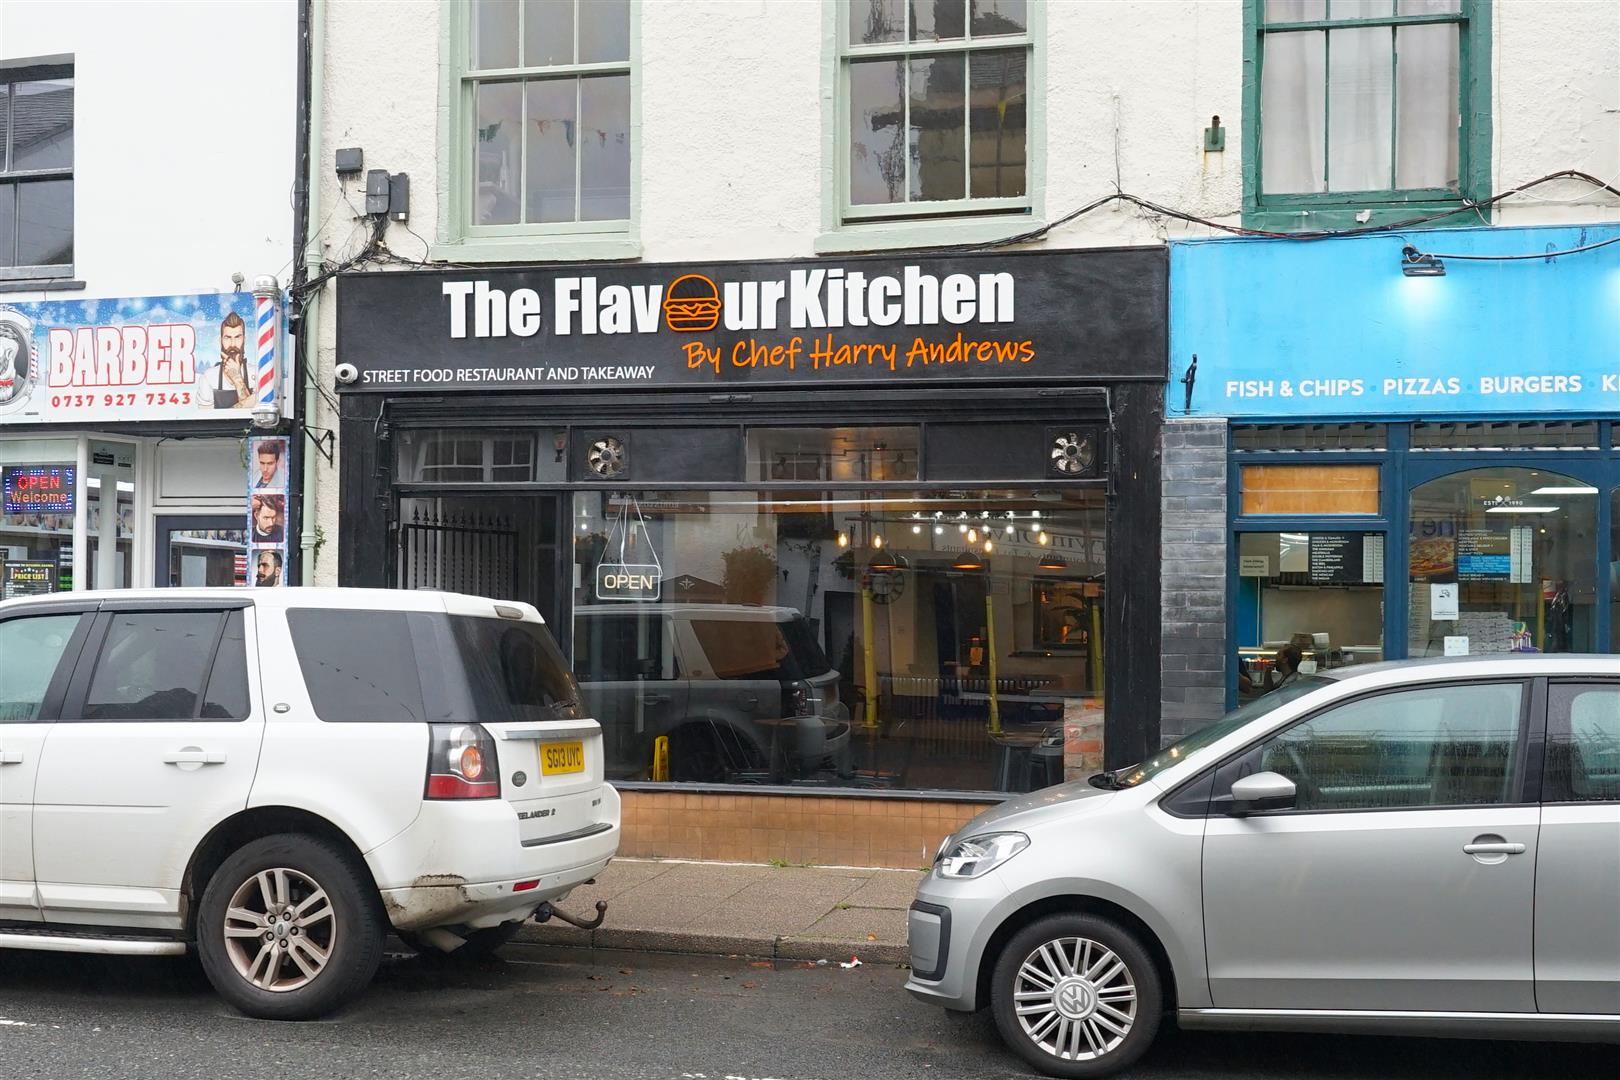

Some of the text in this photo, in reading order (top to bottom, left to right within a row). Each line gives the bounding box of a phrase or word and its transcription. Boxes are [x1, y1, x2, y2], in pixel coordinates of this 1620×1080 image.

[443, 280, 541, 338] The
[49, 323, 195, 387] BARBER
[682, 332, 1036, 373] By Chef Harry Andrews
[362, 366, 656, 383] STREET FOOD RESTAURANT AND TAKEAWAY
[1602, 374, 1620, 392] K
[1226, 380, 1364, 397] FISH & CHIPS
[1383, 377, 1461, 396] PIZZAS
[1480, 375, 1582, 394] BURGERS
[52, 392, 191, 408] 0737 927 7343
[17, 476, 60, 490] OPEN
[10, 491, 68, 503] Welcome
[604, 574, 653, 590] OPEN
[547, 747, 581, 768] SG13 UYC
